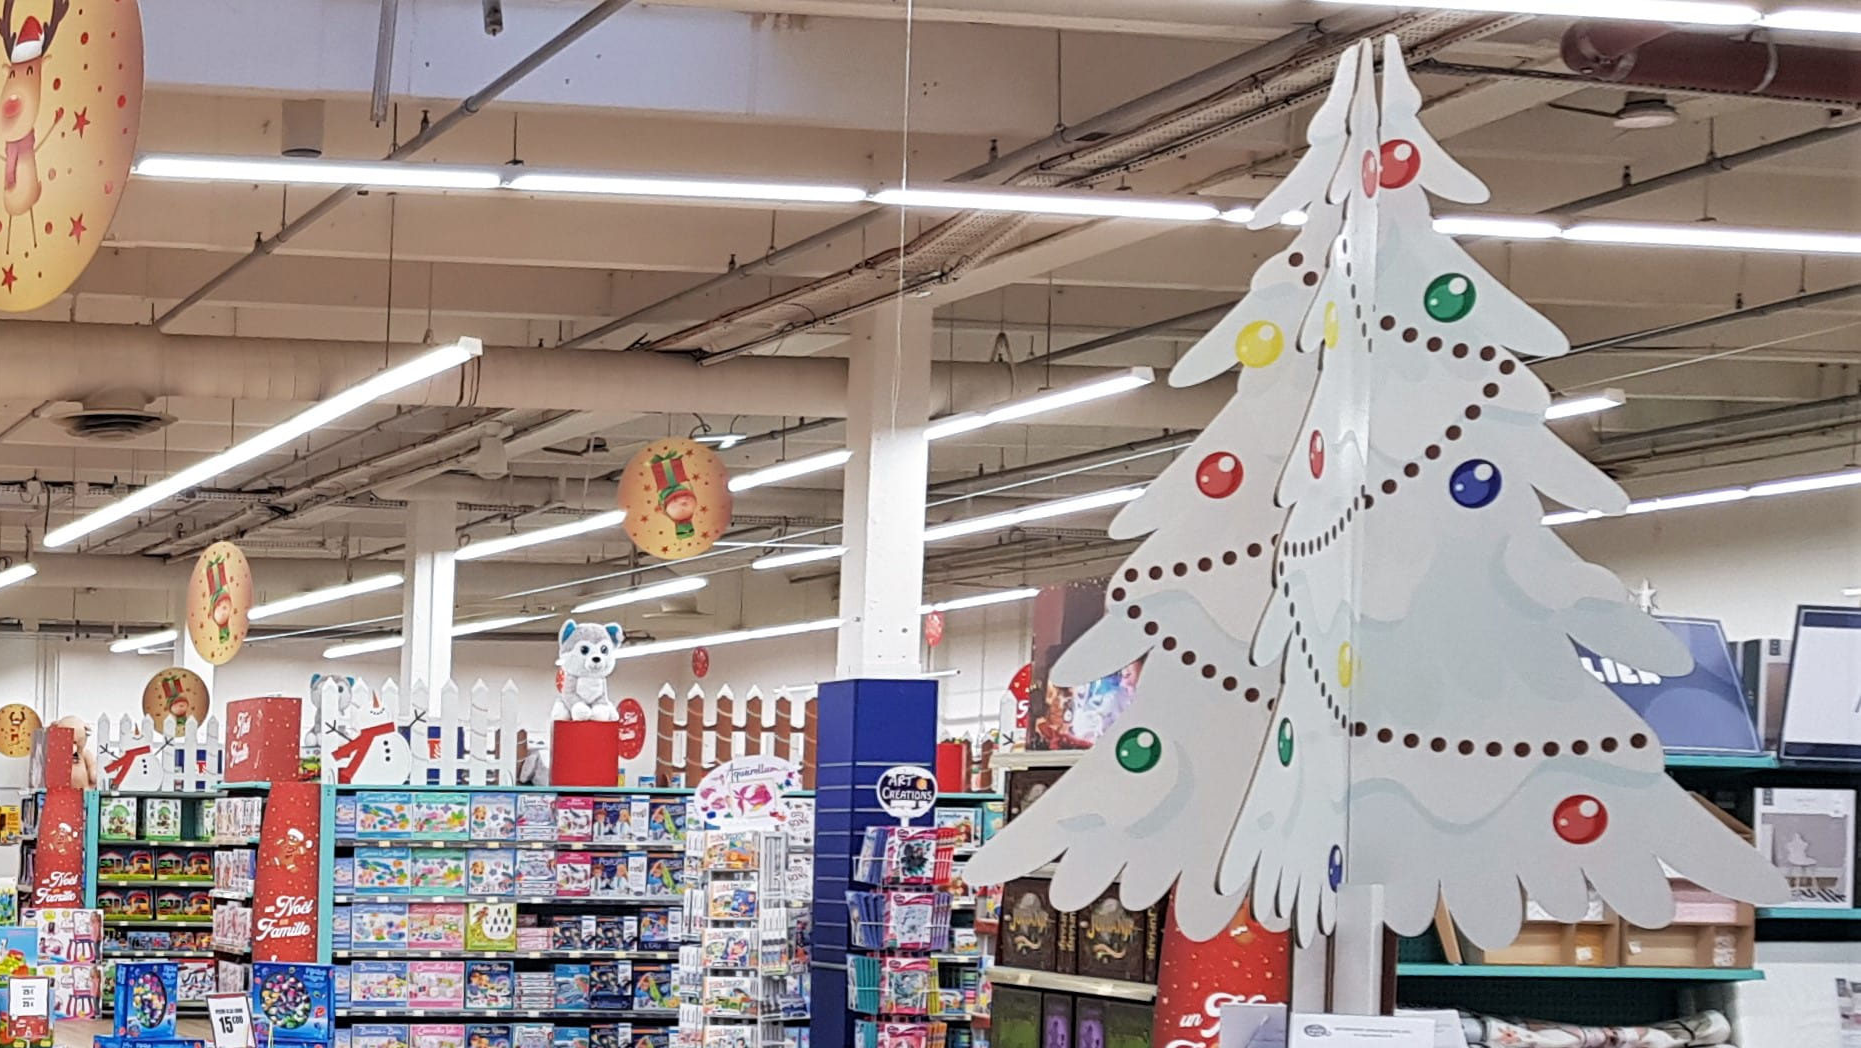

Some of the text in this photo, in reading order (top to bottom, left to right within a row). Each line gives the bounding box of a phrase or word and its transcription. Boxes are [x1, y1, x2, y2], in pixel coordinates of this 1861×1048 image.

[887, 775, 912, 787] ART
[275, 895, 314, 917] Noël
[256, 918, 311, 941] Famille
[1179, 1011, 1203, 1028] un
